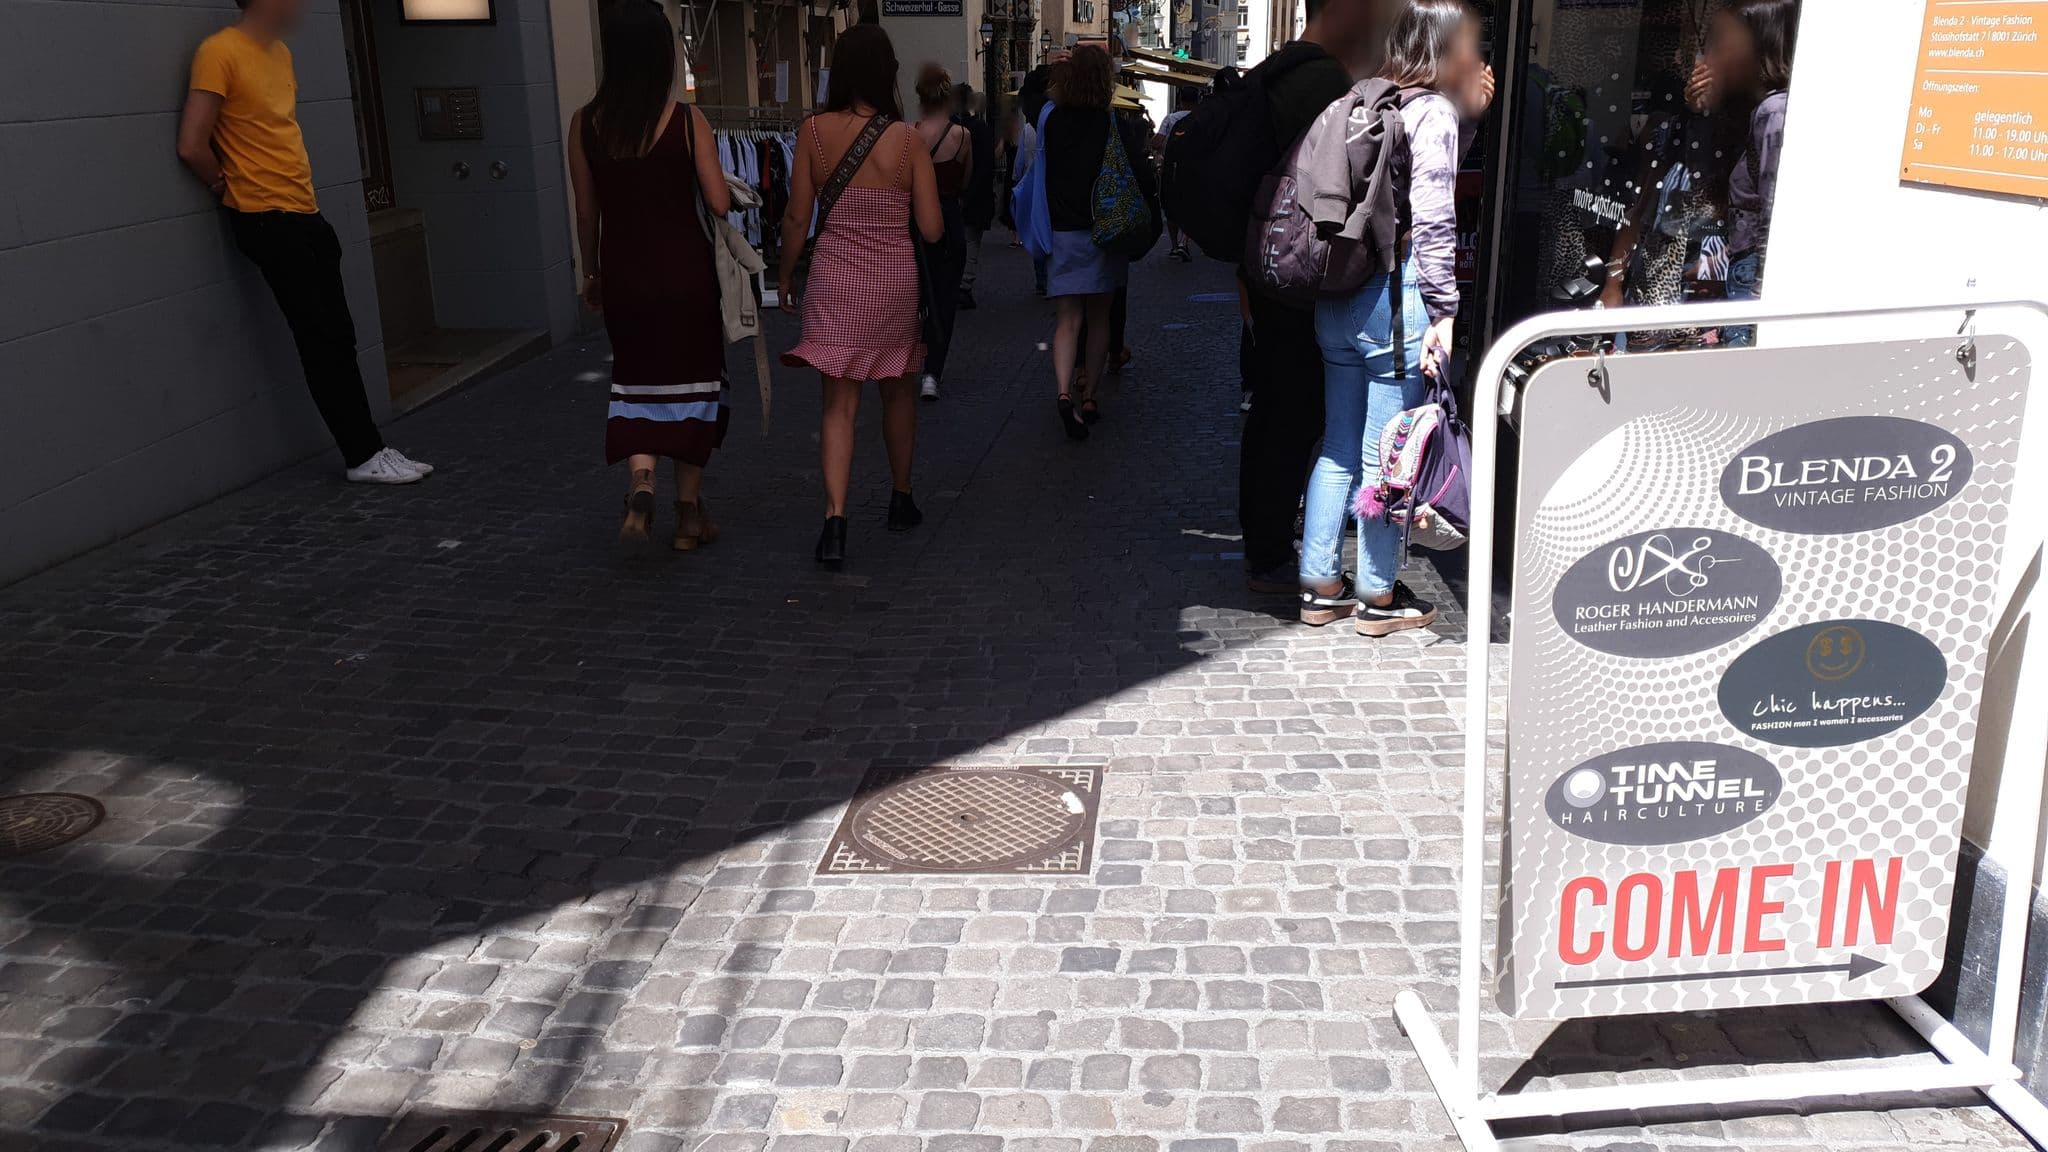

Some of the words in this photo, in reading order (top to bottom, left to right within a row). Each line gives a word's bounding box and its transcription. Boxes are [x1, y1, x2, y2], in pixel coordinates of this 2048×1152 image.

[1933, 16, 1958, 26] Blenda
[1960, 16, 1966, 26] 2
[1971, 15, 2001, 28] Vintage
[2003, 14, 2033, 25] Fashion
[1981, 32, 1987, 41] 7
[1992, 31, 2010, 42] 8001
[2012, 31, 2038, 42] Zürich
[1928, 47, 1985, 58] www.blenda.ch
[1918, 106, 1933, 118] Mo
[1974, 110, 2033, 126] gelegentlich
[1915, 122, 1926, 134] Di
[1932, 123, 1942, 135] Fr
[1973, 127, 1998, 141] 11.00
[2006, 129, 2032, 143] 19.00
[2034, 131, 2048, 145] Uh
[1912, 138, 1924, 151] Sa
[1969, 143, 1995, 157] 11.00
[2003, 146, 2029, 160] 17.00
[1573, 187, 1593, 211] more
[1737, 455, 1918, 495] BLENDA
[1928, 444, 1957, 483] 2
[1773, 488, 1856, 508] VINTAGE
[1864, 482, 1949, 503] FASHION
[1575, 603, 1631, 620] ROGER
[1637, 595, 1759, 616] HANDERMANN
[1574, 620, 1618, 633] Leather
[1619, 616, 1663, 631] Fashion
[1666, 615, 1688, 628] and
[1690, 611, 1757, 626] Accessoires
[1751, 720, 1793, 731] FASHION
[1820, 717, 1849, 727] women
[1857, 712, 1904, 725] accessories
[1611, 759, 1718, 786] TIME
[1609, 777, 1765, 806] TUNNEL
[1561, 799, 1764, 824] HAIRCULTURE
[1557, 863, 1796, 966] COME
[1815, 856, 1904, 949] IN
